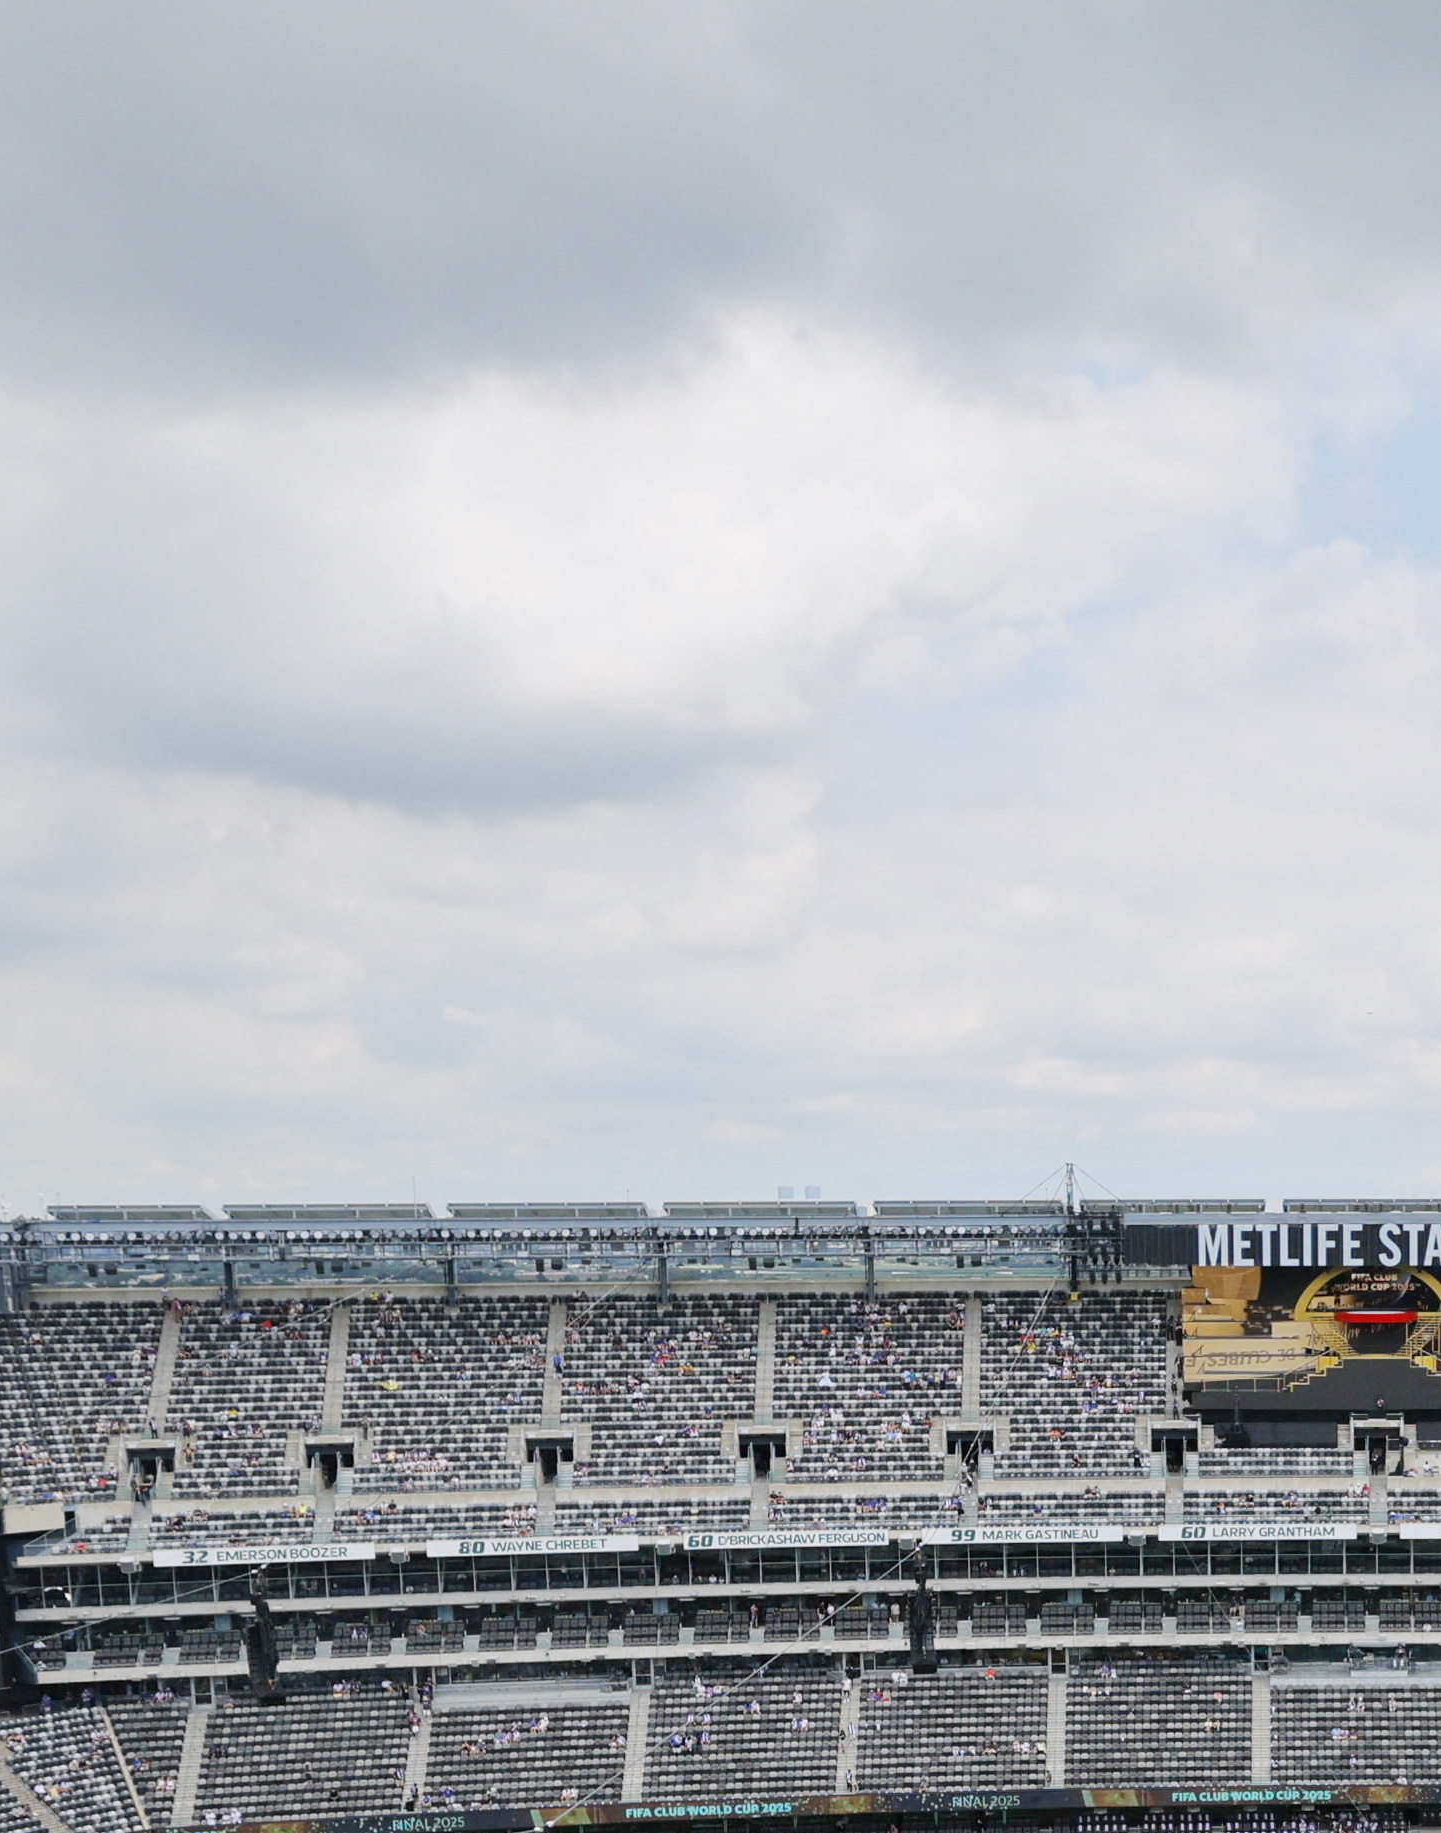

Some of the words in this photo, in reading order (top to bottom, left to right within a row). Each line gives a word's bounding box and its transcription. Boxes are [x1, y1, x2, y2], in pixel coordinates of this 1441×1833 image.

[1197, 1223, 1364, 1267] METLIFE
[687, 1535, 713, 1547] 60
[718, 1533, 816, 1546] D'BRICKASHAW
[818, 1532, 885, 1544] FERGUSON
[951, 1530, 976, 1542] 99
[982, 1530, 1022, 1540] MARK
[1025, 1529, 1098, 1540] GASTINEAU
[1181, 1526, 1206, 1538] 60
[1212, 1527, 1255, 1537] LARRY
[1259, 1526, 1335, 1537] GRANTHAM
[459, 1541, 485, 1554] 80
[491, 1541, 543, 1552] WAYNE
[546, 1539, 607, 1550] CHREBET
[182, 1551, 208, 1564] 32
[216, 1549, 288, 1561] EMERSON
[290, 1547, 347, 1559] BOOZER
[952, 1796, 988, 1808] FINAL
[990, 1795, 1021, 1807] 2025
[1171, 1792, 1197, 1802] FIFA
[1199, 1792, 1229, 1801] CLUB
[1229, 1791, 1274, 1800] WORLD
[1276, 1791, 1299, 1800] CUP
[1302, 1790, 1332, 1800] 2025
[625, 1808, 652, 1818] FIFA
[653, 1806, 686, 1818] CLUB
[686, 1805, 732, 1817] WORLD
[734, 1803, 760, 1815] CUP
[761, 1802, 792, 1814] 2025
[392, 1818, 433, 1832] FINAL
[433, 1816, 465, 1830] 2025
